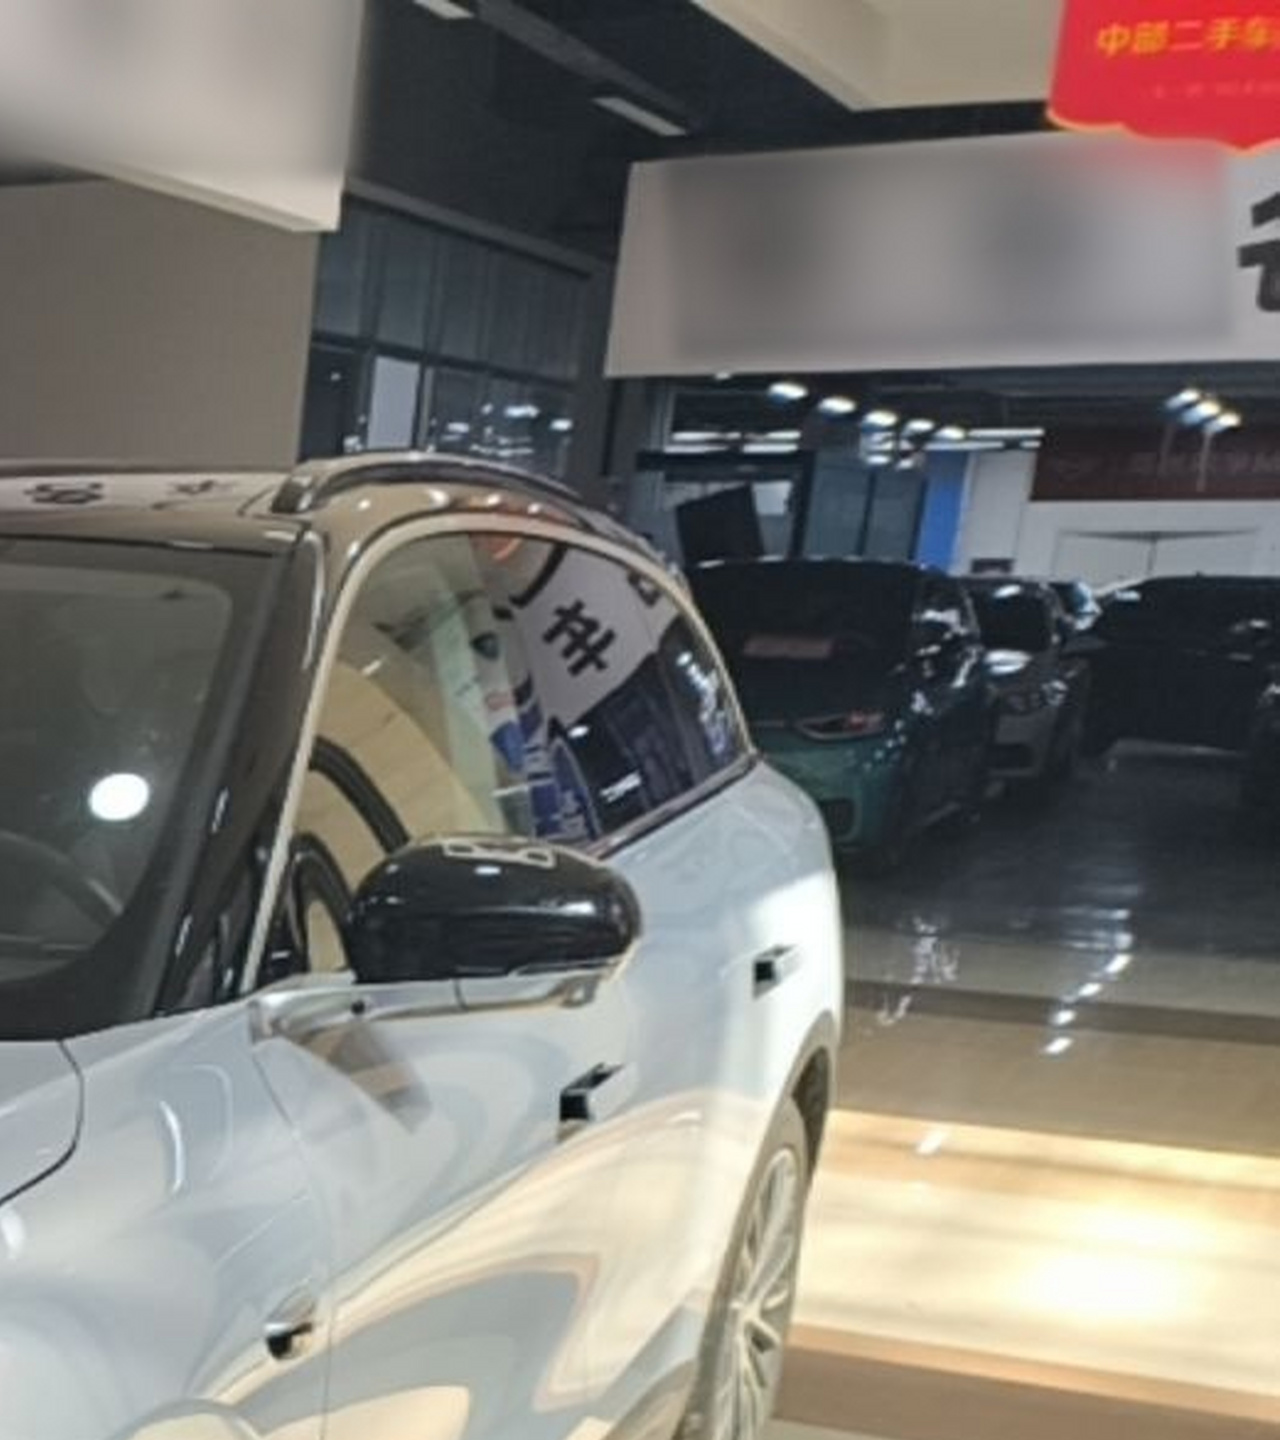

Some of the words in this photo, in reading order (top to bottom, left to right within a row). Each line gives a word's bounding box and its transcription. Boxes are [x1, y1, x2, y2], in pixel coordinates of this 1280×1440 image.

[1095, 16, 1280, 58] 中部二手车
